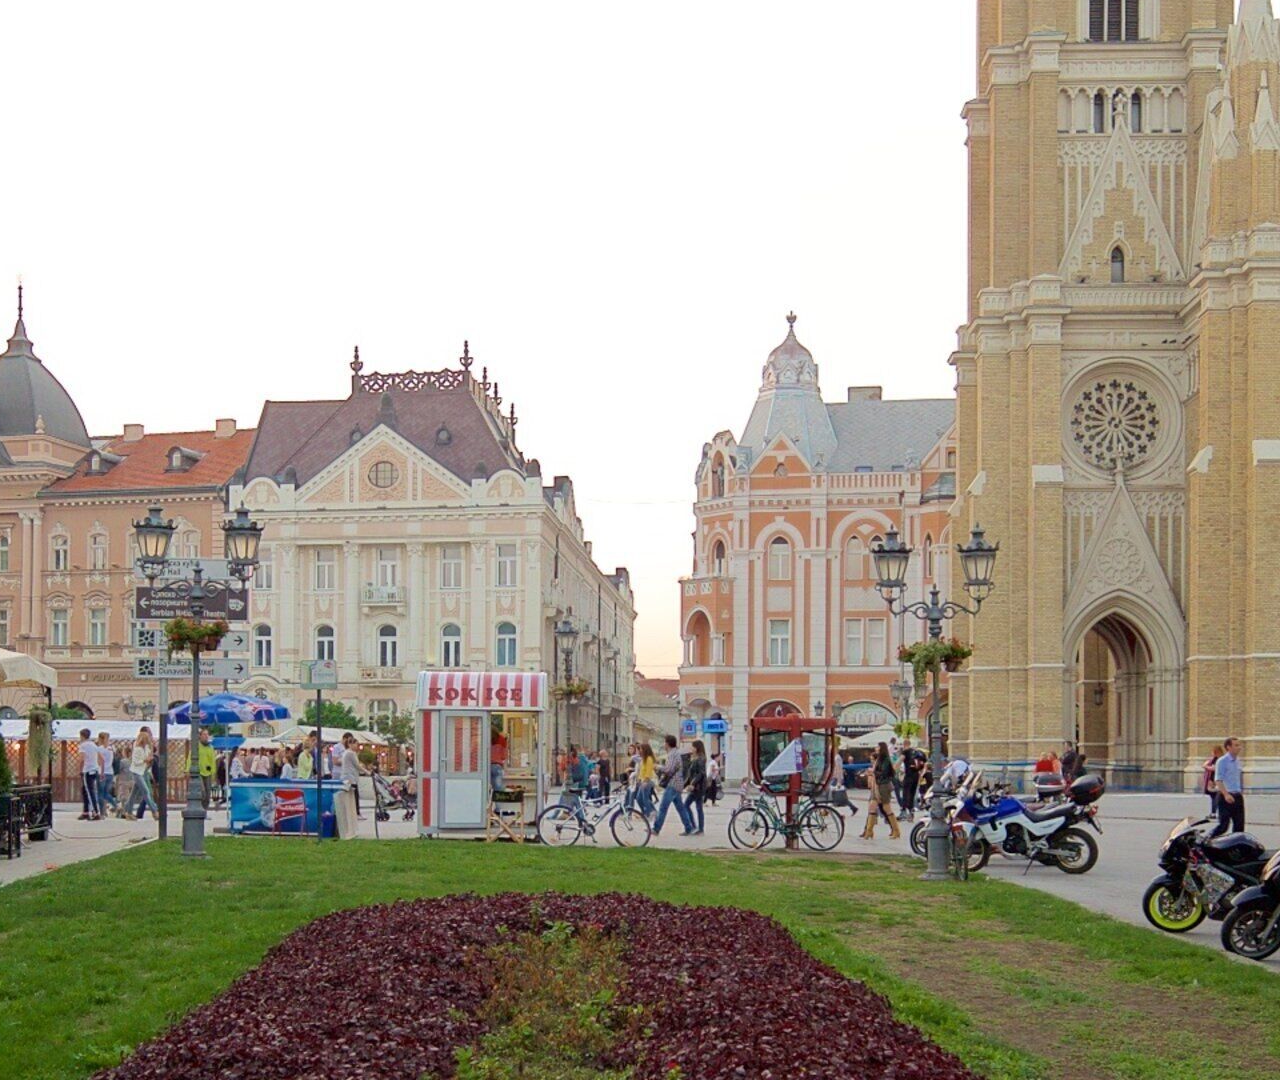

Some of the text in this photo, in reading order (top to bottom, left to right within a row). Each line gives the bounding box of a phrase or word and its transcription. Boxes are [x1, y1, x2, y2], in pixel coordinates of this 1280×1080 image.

[151, 608, 174, 617] Serbian
[428, 687, 523, 701] KOK ICE
